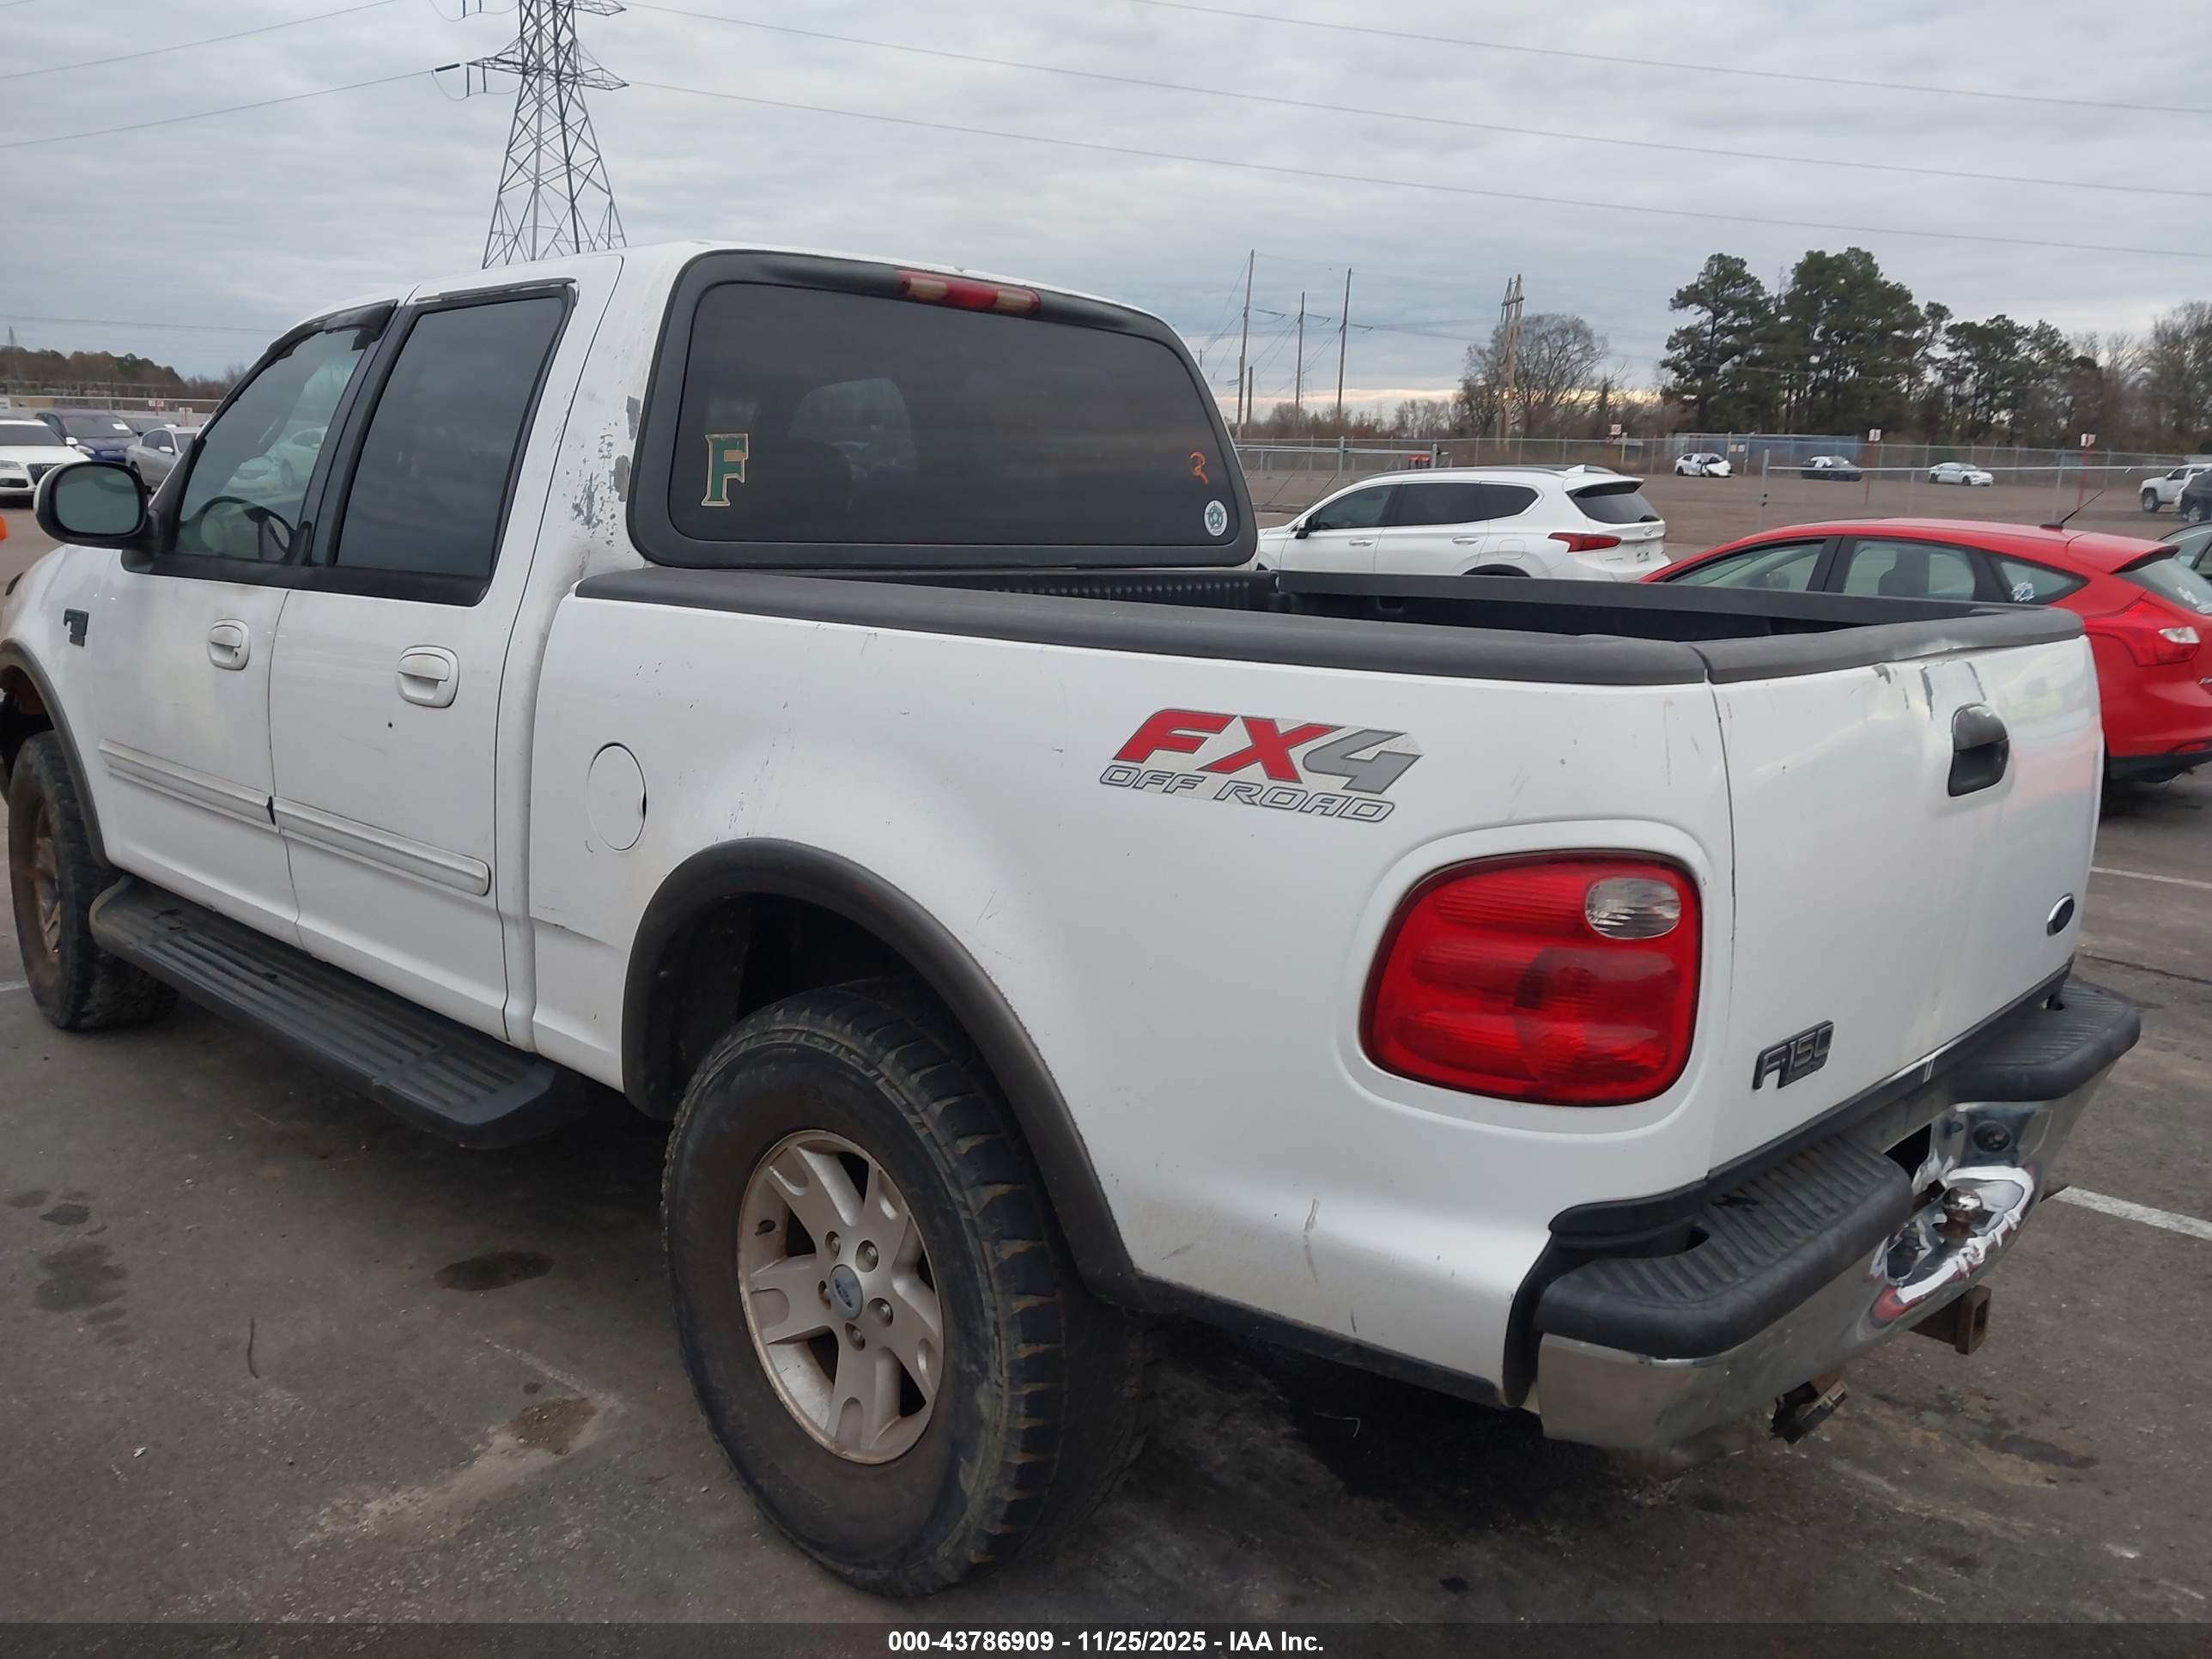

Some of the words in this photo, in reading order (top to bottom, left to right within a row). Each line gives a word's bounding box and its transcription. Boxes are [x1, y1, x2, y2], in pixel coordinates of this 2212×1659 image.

[702, 433, 749, 507] F
[1112, 708, 1422, 795] FX4
[1099, 764, 1206, 794] OFF
[1212, 780, 1395, 823] ROAD
